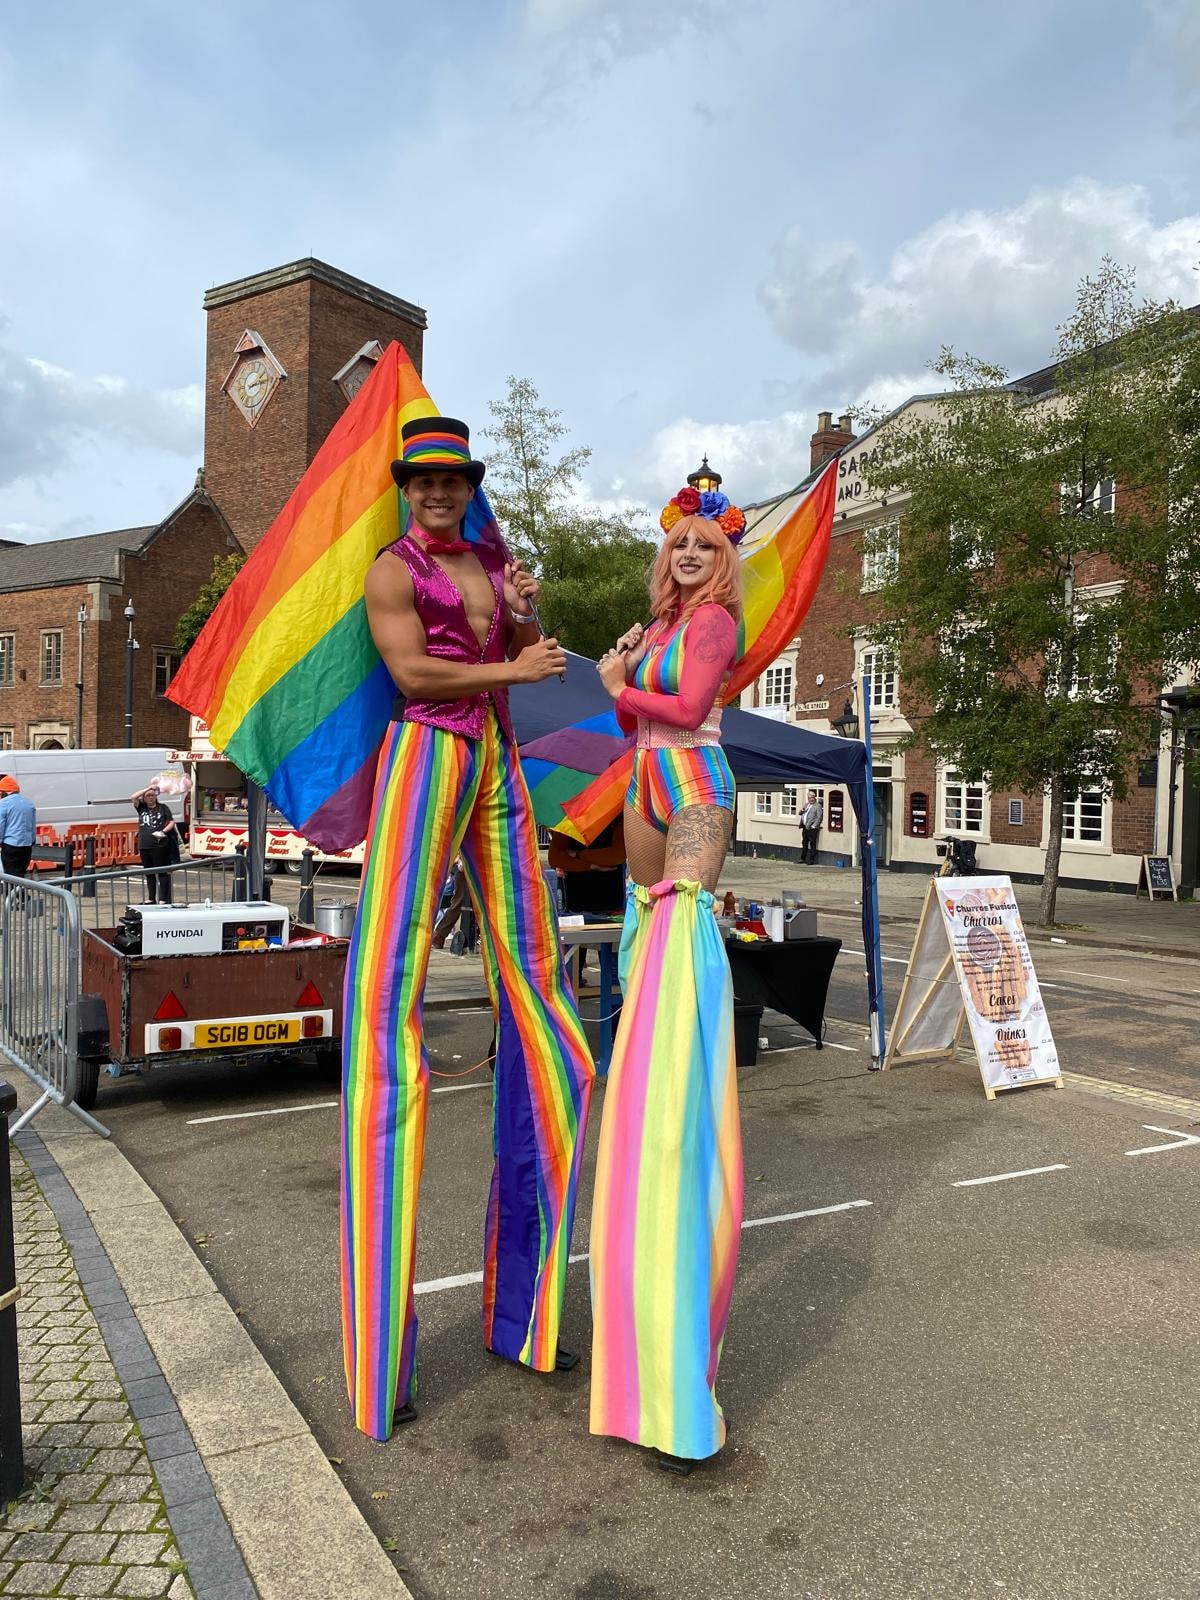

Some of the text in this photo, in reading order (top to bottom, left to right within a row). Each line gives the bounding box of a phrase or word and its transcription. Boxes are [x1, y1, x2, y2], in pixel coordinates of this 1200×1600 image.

[838, 481, 862, 502] AND
[956, 902, 1017, 913] Churros Fusion
[963, 915, 1003, 928] Churros
[156, 929, 203, 938] HYUNDAI
[989, 993, 1016, 1007] Cakes
[207, 1023, 289, 1044] SG18 OGM
[995, 1027, 1026, 1041] Drinks
